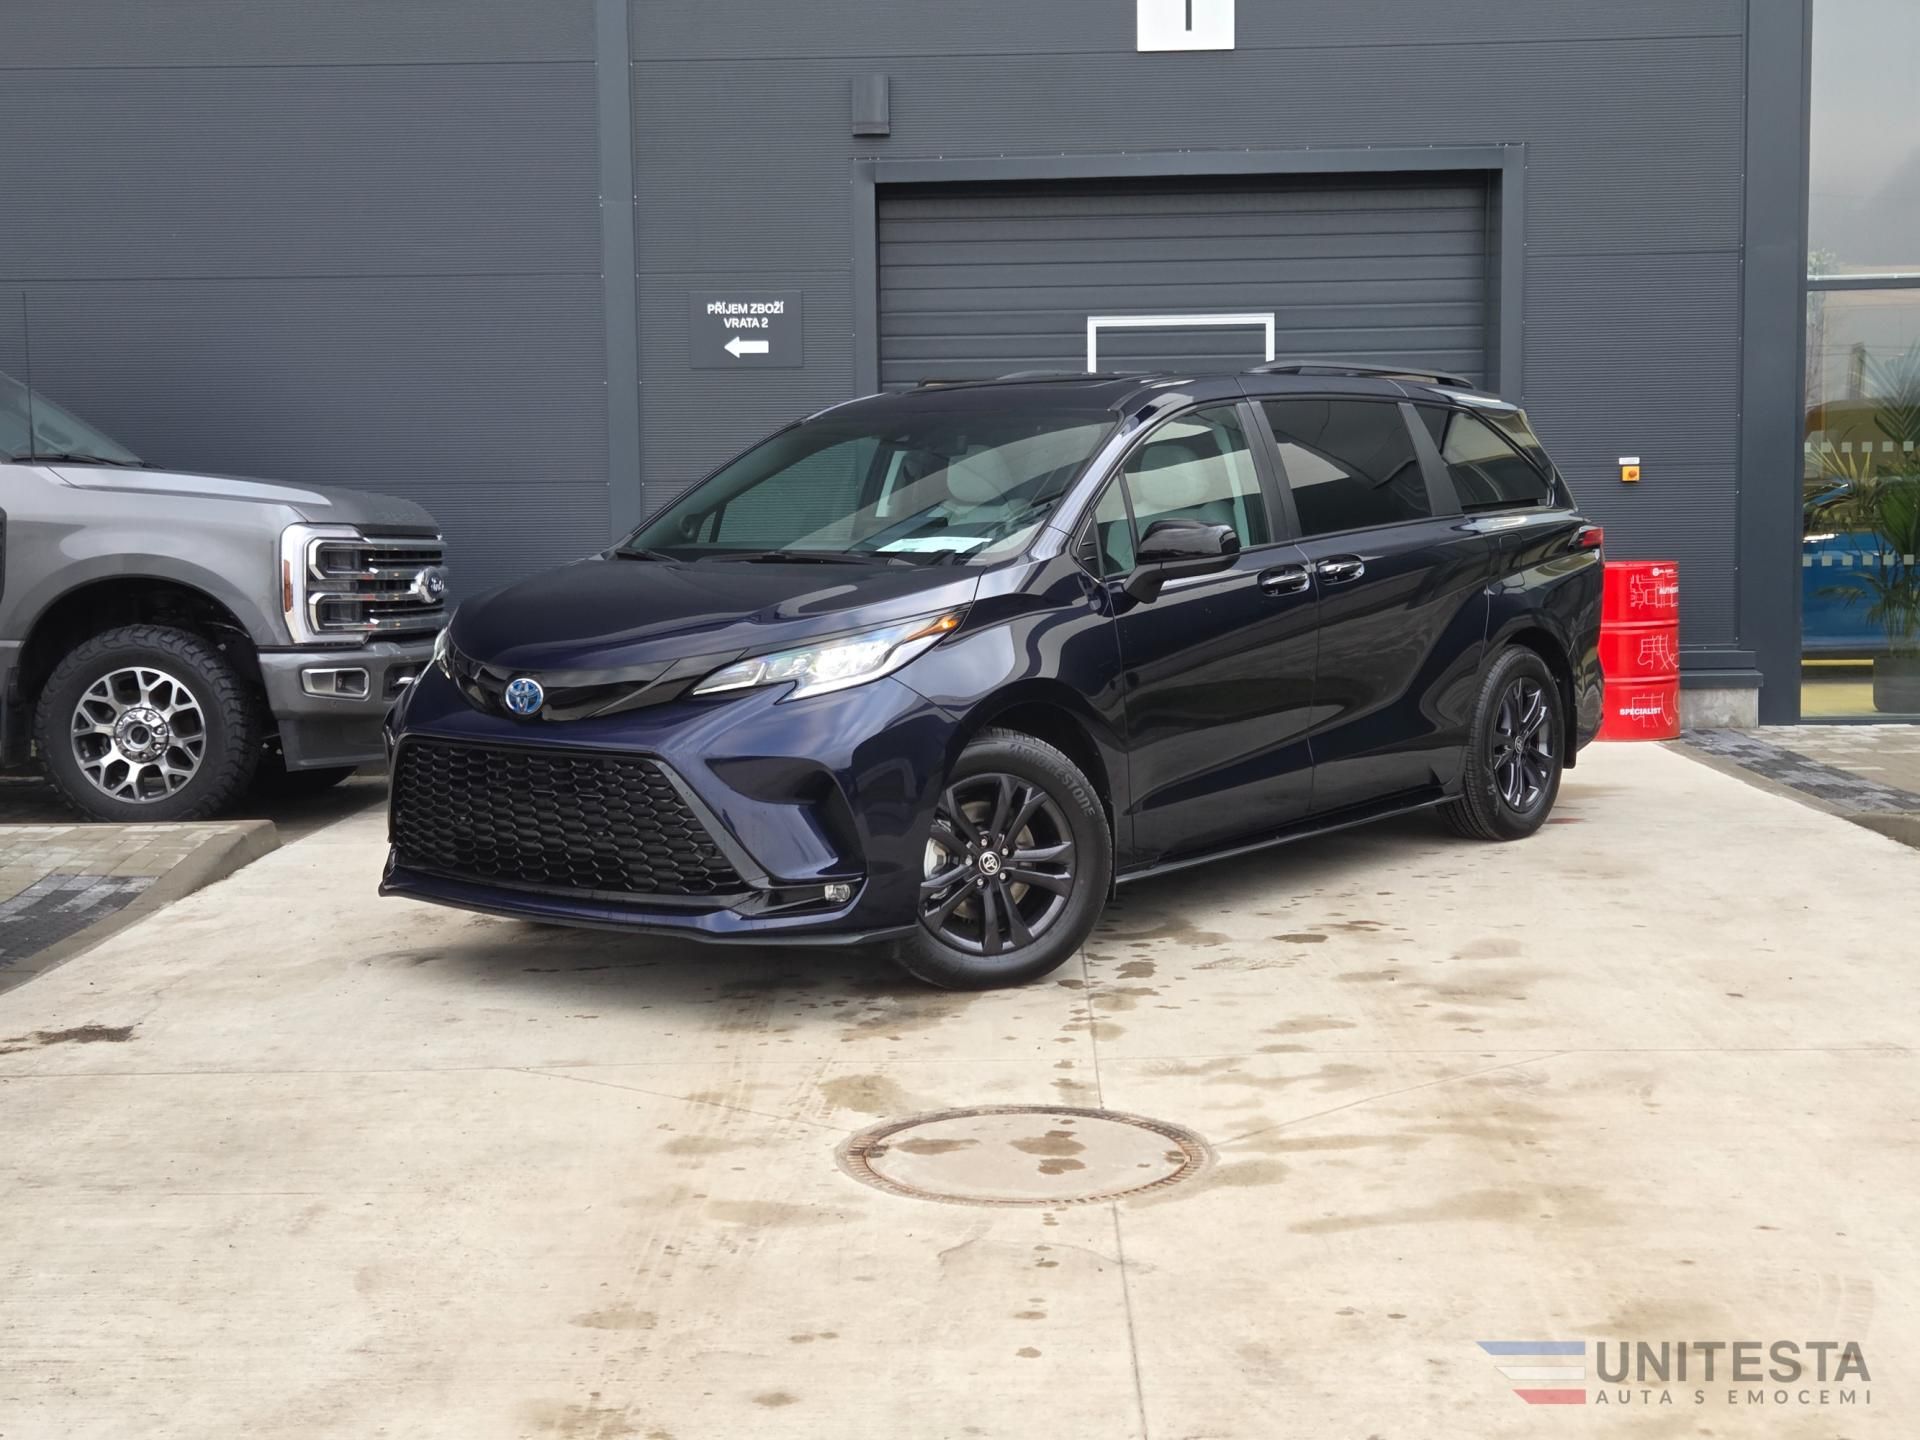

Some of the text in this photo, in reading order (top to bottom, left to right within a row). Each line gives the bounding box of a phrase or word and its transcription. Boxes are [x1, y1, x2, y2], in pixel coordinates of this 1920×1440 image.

[707, 300, 784, 314] PŘÍJEM ZBOŽÍ
[723, 317, 769, 329] VRATA 2
[1619, 707, 1662, 716] SPECIALIST
